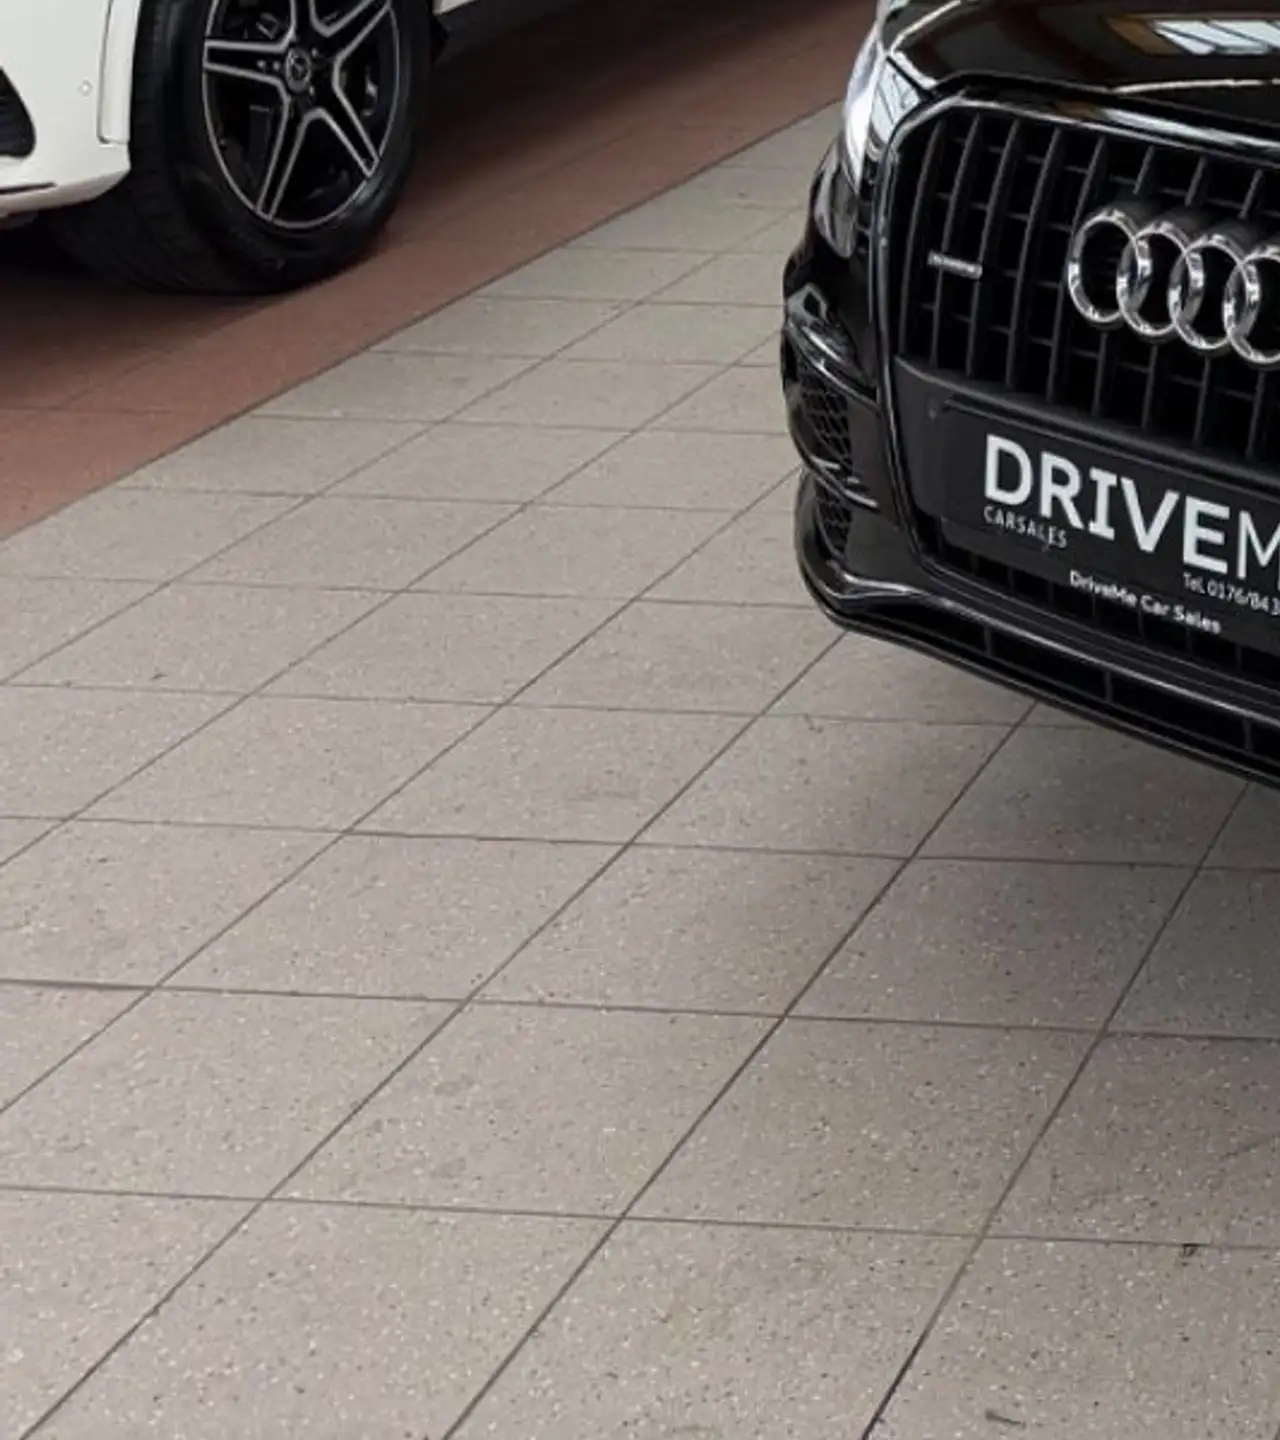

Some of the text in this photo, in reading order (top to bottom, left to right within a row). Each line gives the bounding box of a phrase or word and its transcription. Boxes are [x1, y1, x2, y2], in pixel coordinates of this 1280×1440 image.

[983, 504, 1068, 549] CARSALES
[1139, 594, 1171, 617] Car
[1173, 603, 1222, 635] Sales
